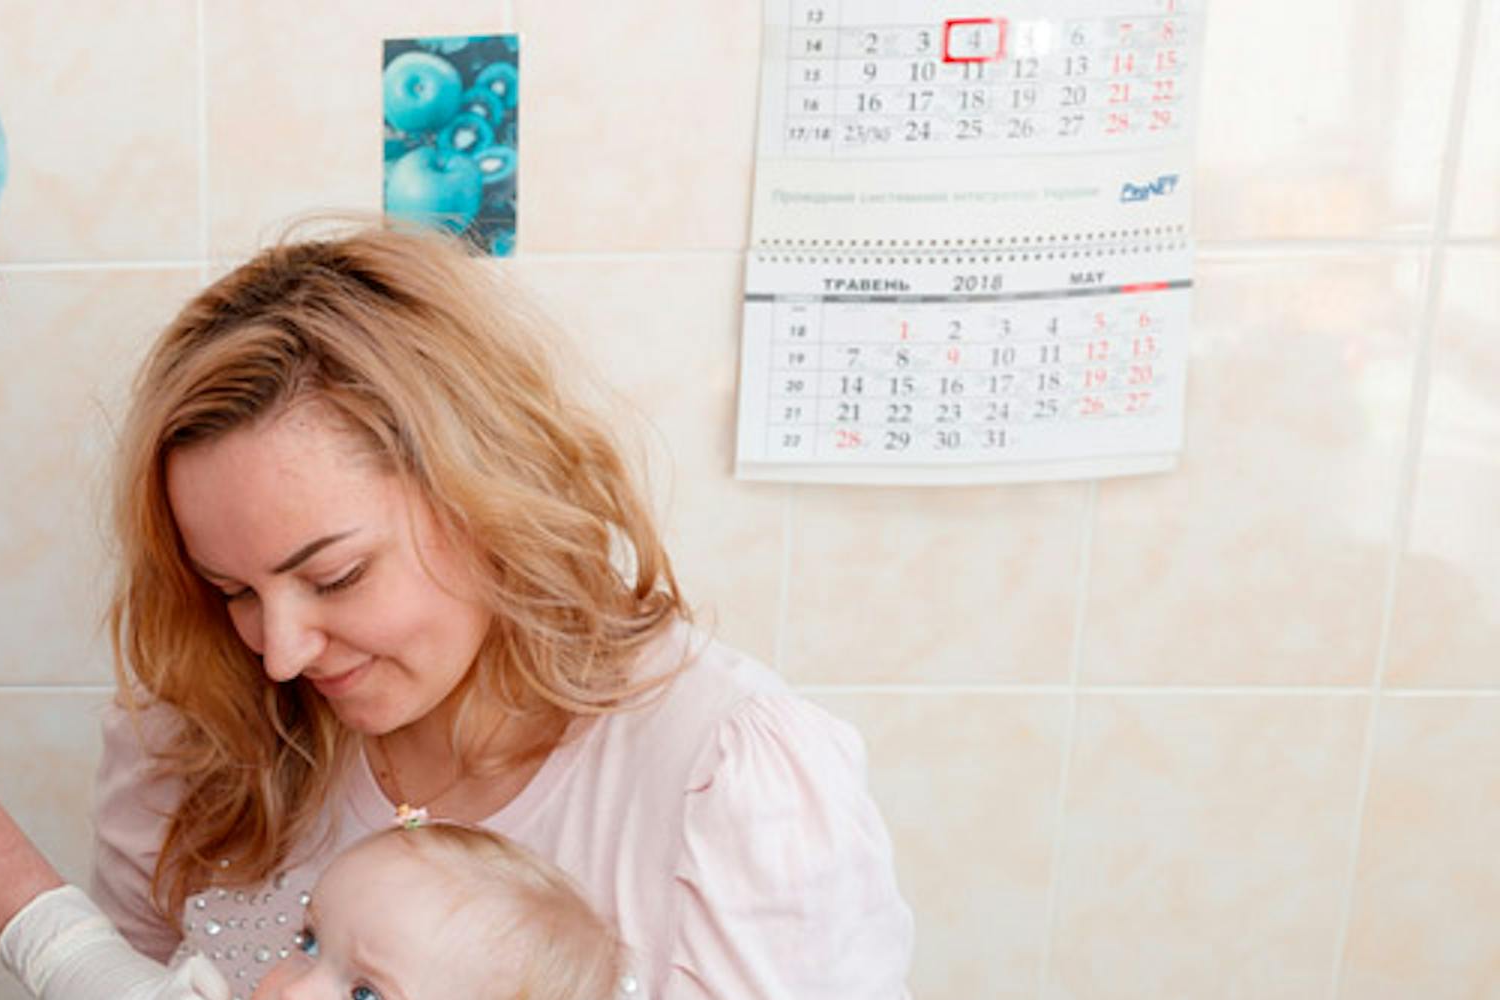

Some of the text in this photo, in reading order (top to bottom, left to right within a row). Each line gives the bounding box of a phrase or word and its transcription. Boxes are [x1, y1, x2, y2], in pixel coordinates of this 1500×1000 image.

[864, 31, 879, 53] 2
[917, 31, 931, 53] 3
[967, 30, 981, 50] 4
[1070, 25, 1085, 46] 6
[1119, 23, 1134, 43] 7
[863, 62, 877, 81] 9
[910, 61, 937, 82] 10
[961, 61, 985, 80] 11
[1013, 58, 1039, 79] 12
[1063, 55, 1089, 77] 13
[1113, 52, 1134, 74] 14
[1156, 50, 1177, 72] 15
[857, 93, 883, 113] 16
[908, 91, 934, 112] 17
[960, 90, 985, 111] 18
[1011, 89, 1037, 109] 19
[1060, 85, 1087, 107] 20
[1108, 83, 1131, 105] 21
[1151, 80, 1174, 101] 22
[905, 120, 932, 142] 24
[955, 119, 983, 139] 25
[1007, 118, 1033, 139] 26
[1057, 115, 1085, 137] 27
[1104, 113, 1129, 135] 28
[1147, 110, 1173, 131] 29
[823, 277, 911, 292] ТРАВЕНЬ
[951, 273, 1004, 293] 2018
[1069, 271, 1106, 285] MAY
[899, 319, 909, 340] 1
[947, 320, 961, 340] 2
[1000, 318, 1011, 338] 3
[1047, 317, 1058, 336] 4
[847, 347, 860, 367] 7
[895, 349, 909, 368] 8
[947, 347, 960, 365] 9
[991, 347, 1016, 367] 10
[1040, 344, 1060, 364] 11
[1085, 339, 1109, 361] 12
[1133, 335, 1155, 357] 13
[840, 376, 864, 395] 14
[889, 377, 914, 397] 15
[940, 377, 964, 395] 16
[989, 375, 1015, 393] 17
[1037, 372, 1061, 392] 18
[1084, 368, 1107, 388] 19
[1127, 365, 1153, 385] 20
[836, 403, 860, 422] 21
[885, 403, 913, 423] 22
[935, 404, 961, 423] 23
[984, 401, 1009, 421] 24
[1033, 399, 1059, 419] 25
[1080, 396, 1105, 416] 26
[1124, 391, 1151, 412] 27
[835, 430, 862, 449] 28
[884, 431, 911, 451] 29
[934, 431, 961, 451] 30
[982, 429, 1006, 449] 31
